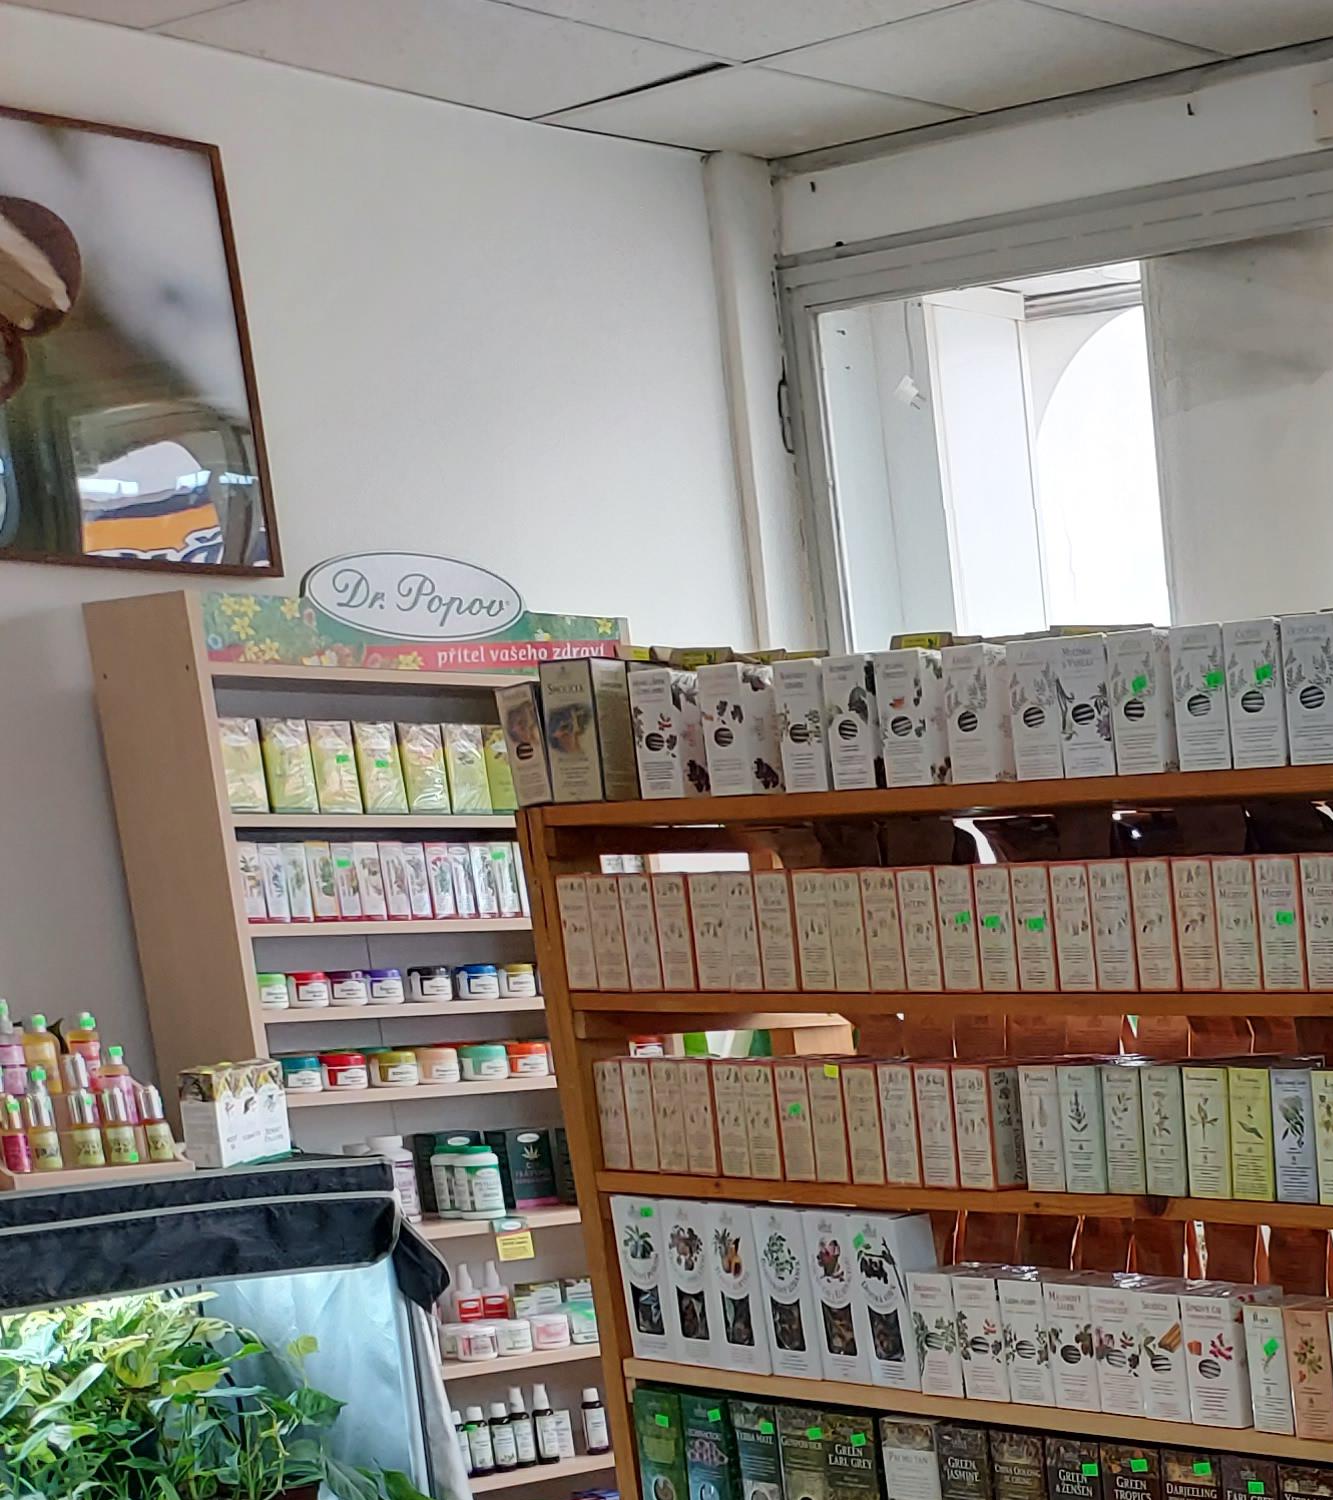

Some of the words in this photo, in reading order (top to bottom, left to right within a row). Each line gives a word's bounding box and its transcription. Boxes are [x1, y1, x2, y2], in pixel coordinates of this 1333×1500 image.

[332, 568, 385, 609] Dr.
[397, 573, 505, 627] Popov
[438, 652, 485, 667] přítel
[489, 645, 547, 662] vašeho
